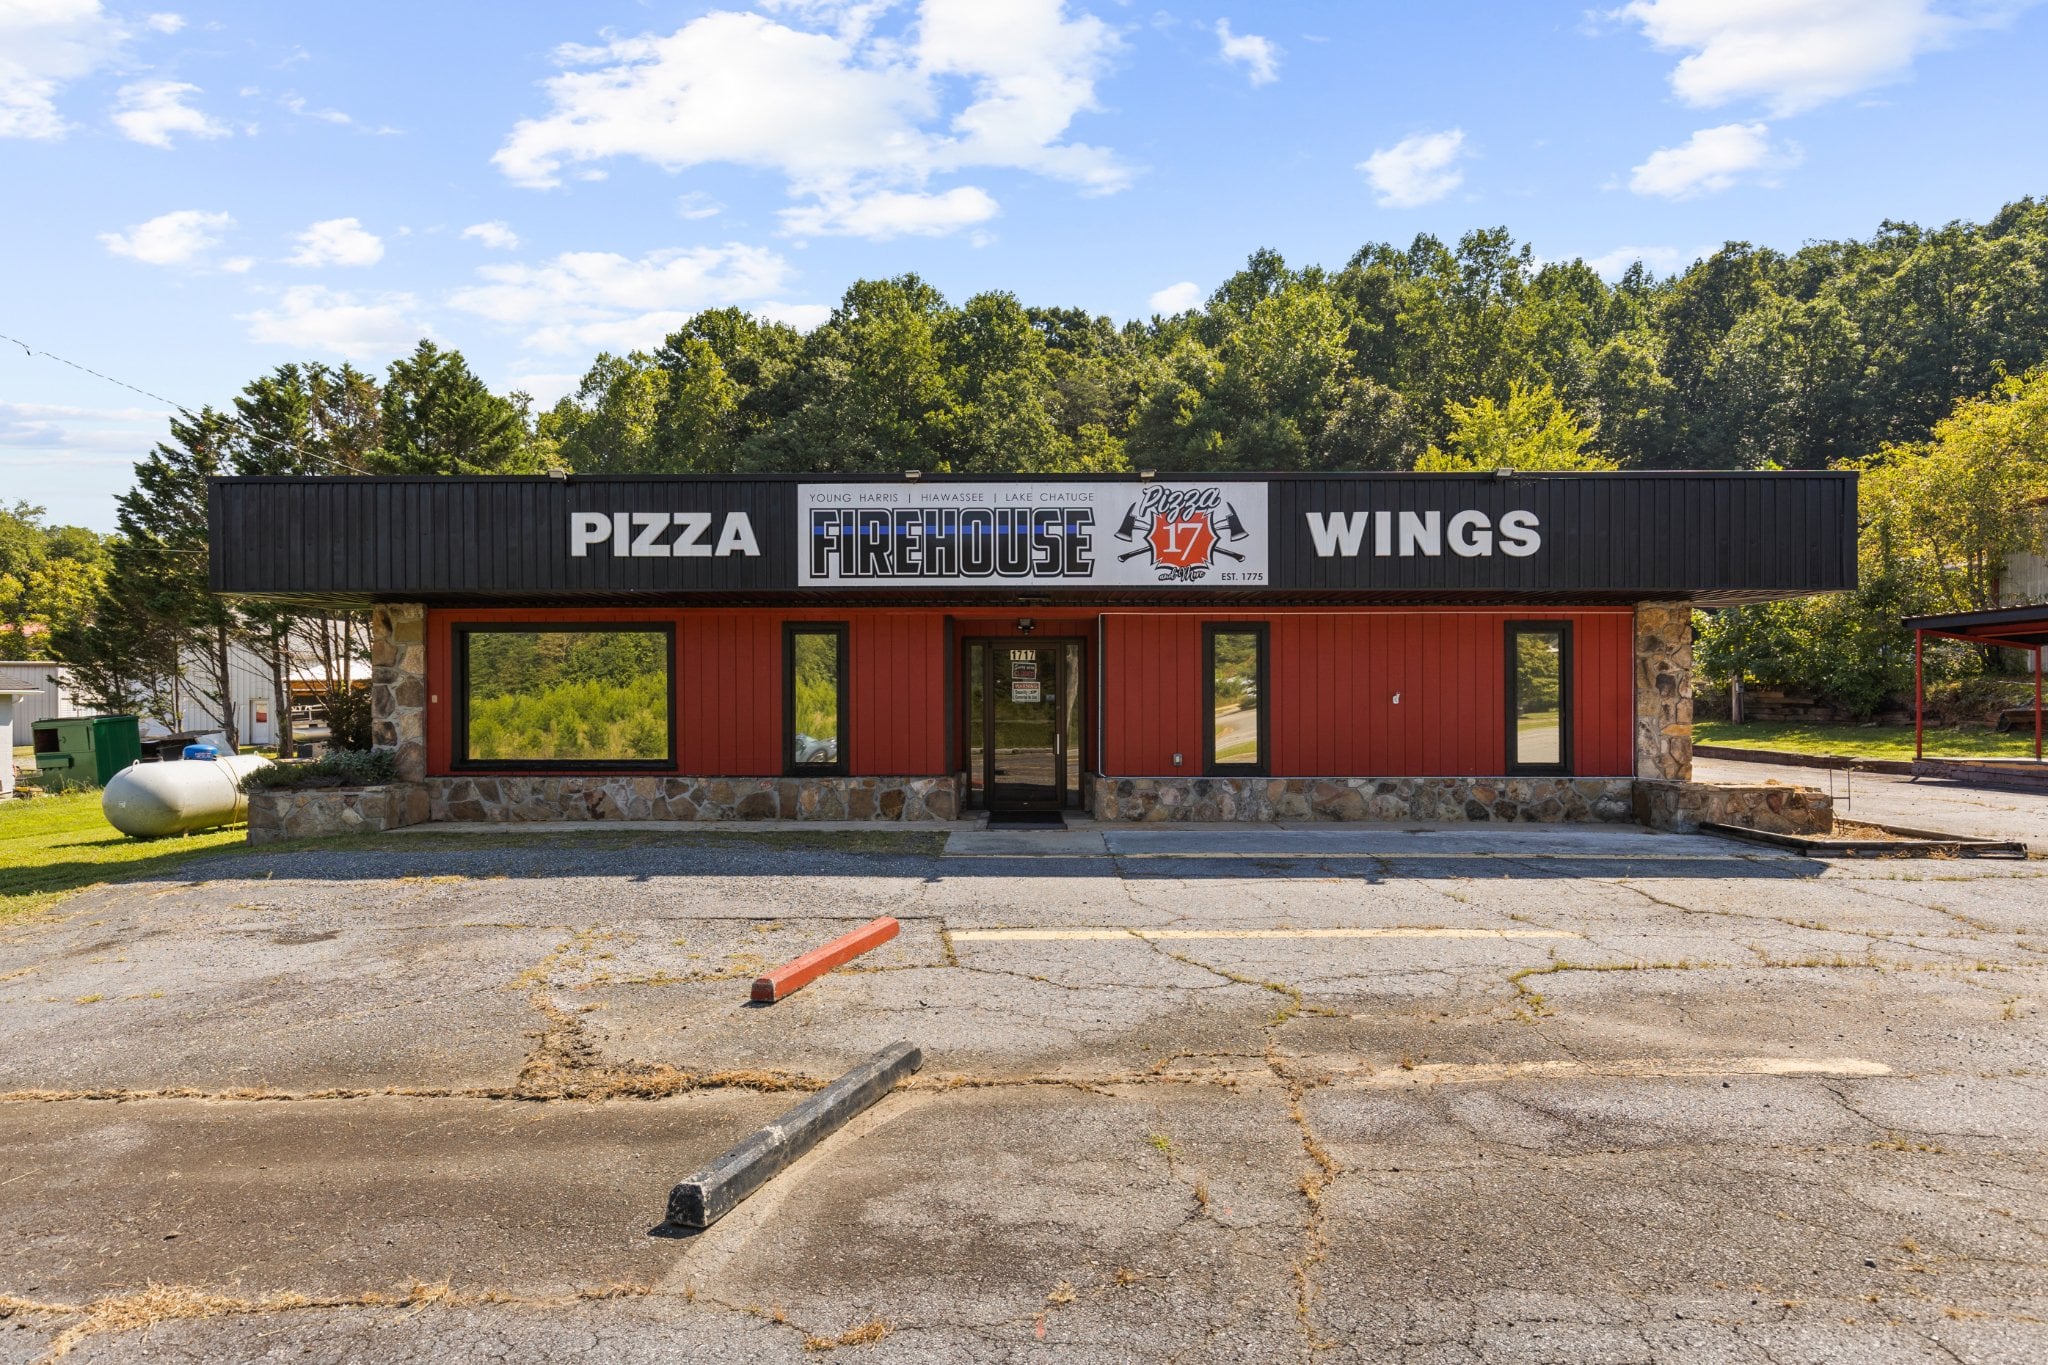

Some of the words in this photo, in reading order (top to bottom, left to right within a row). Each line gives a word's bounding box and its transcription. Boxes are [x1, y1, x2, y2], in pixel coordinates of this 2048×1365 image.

[809, 493, 852, 503] YOUNG
[859, 493, 899, 502] HARRIS
[921, 492, 984, 502] HIAWASSEE
[1005, 492, 1033, 502] LAKE
[1039, 492, 1095, 502] CHATUGE
[1139, 485, 1221, 523] Pizza
[571, 512, 761, 557] PIZZA
[809, 507, 1096, 579] FIREHOUSE
[1162, 522, 1204, 561] 17
[1305, 510, 1542, 557] WINGS
[1221, 572, 1239, 581] EST.
[1241, 572, 1264, 581] 1775
[1011, 650, 1035, 660] 1717
